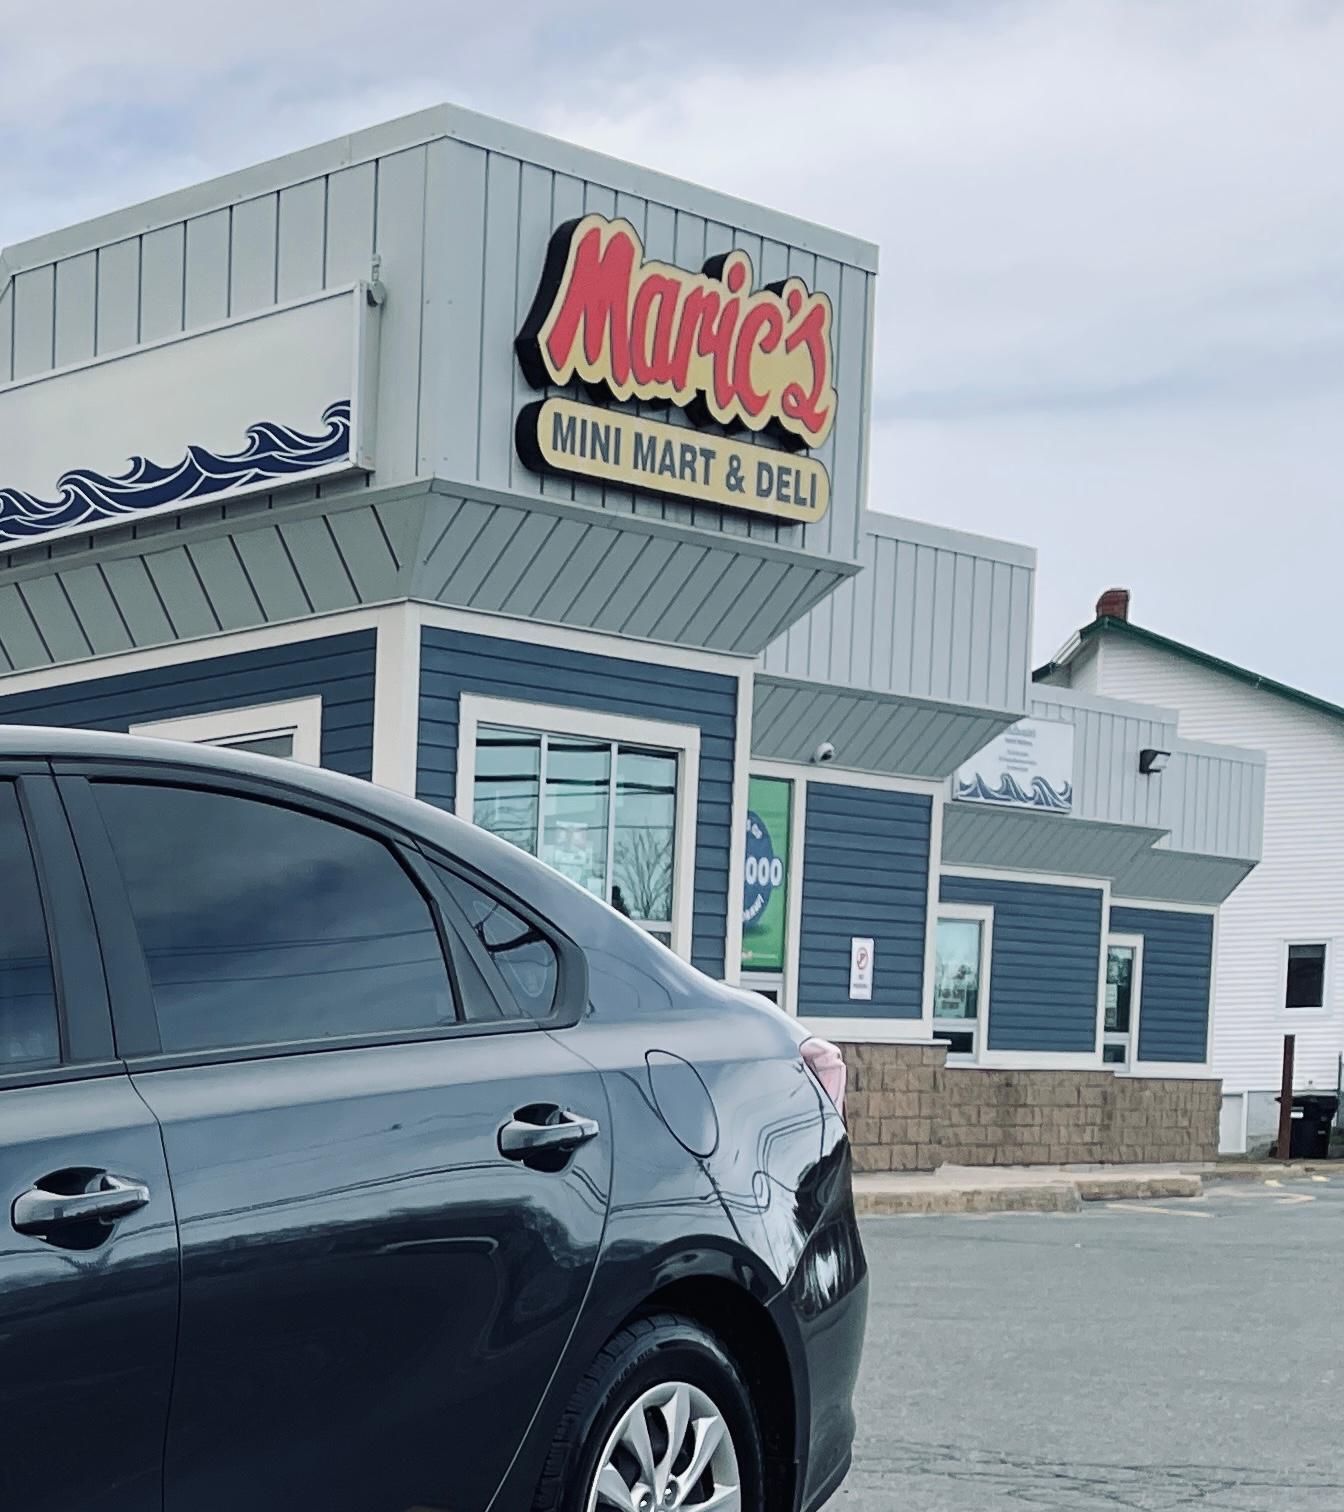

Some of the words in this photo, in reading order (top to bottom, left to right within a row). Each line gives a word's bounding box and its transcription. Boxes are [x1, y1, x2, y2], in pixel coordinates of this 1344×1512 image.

[545, 226, 830, 434] Marie's
[551, 411, 622, 466] MINI
[632, 430, 717, 486] MART
[725, 453, 746, 494] &
[756, 460, 817, 509] DELI
